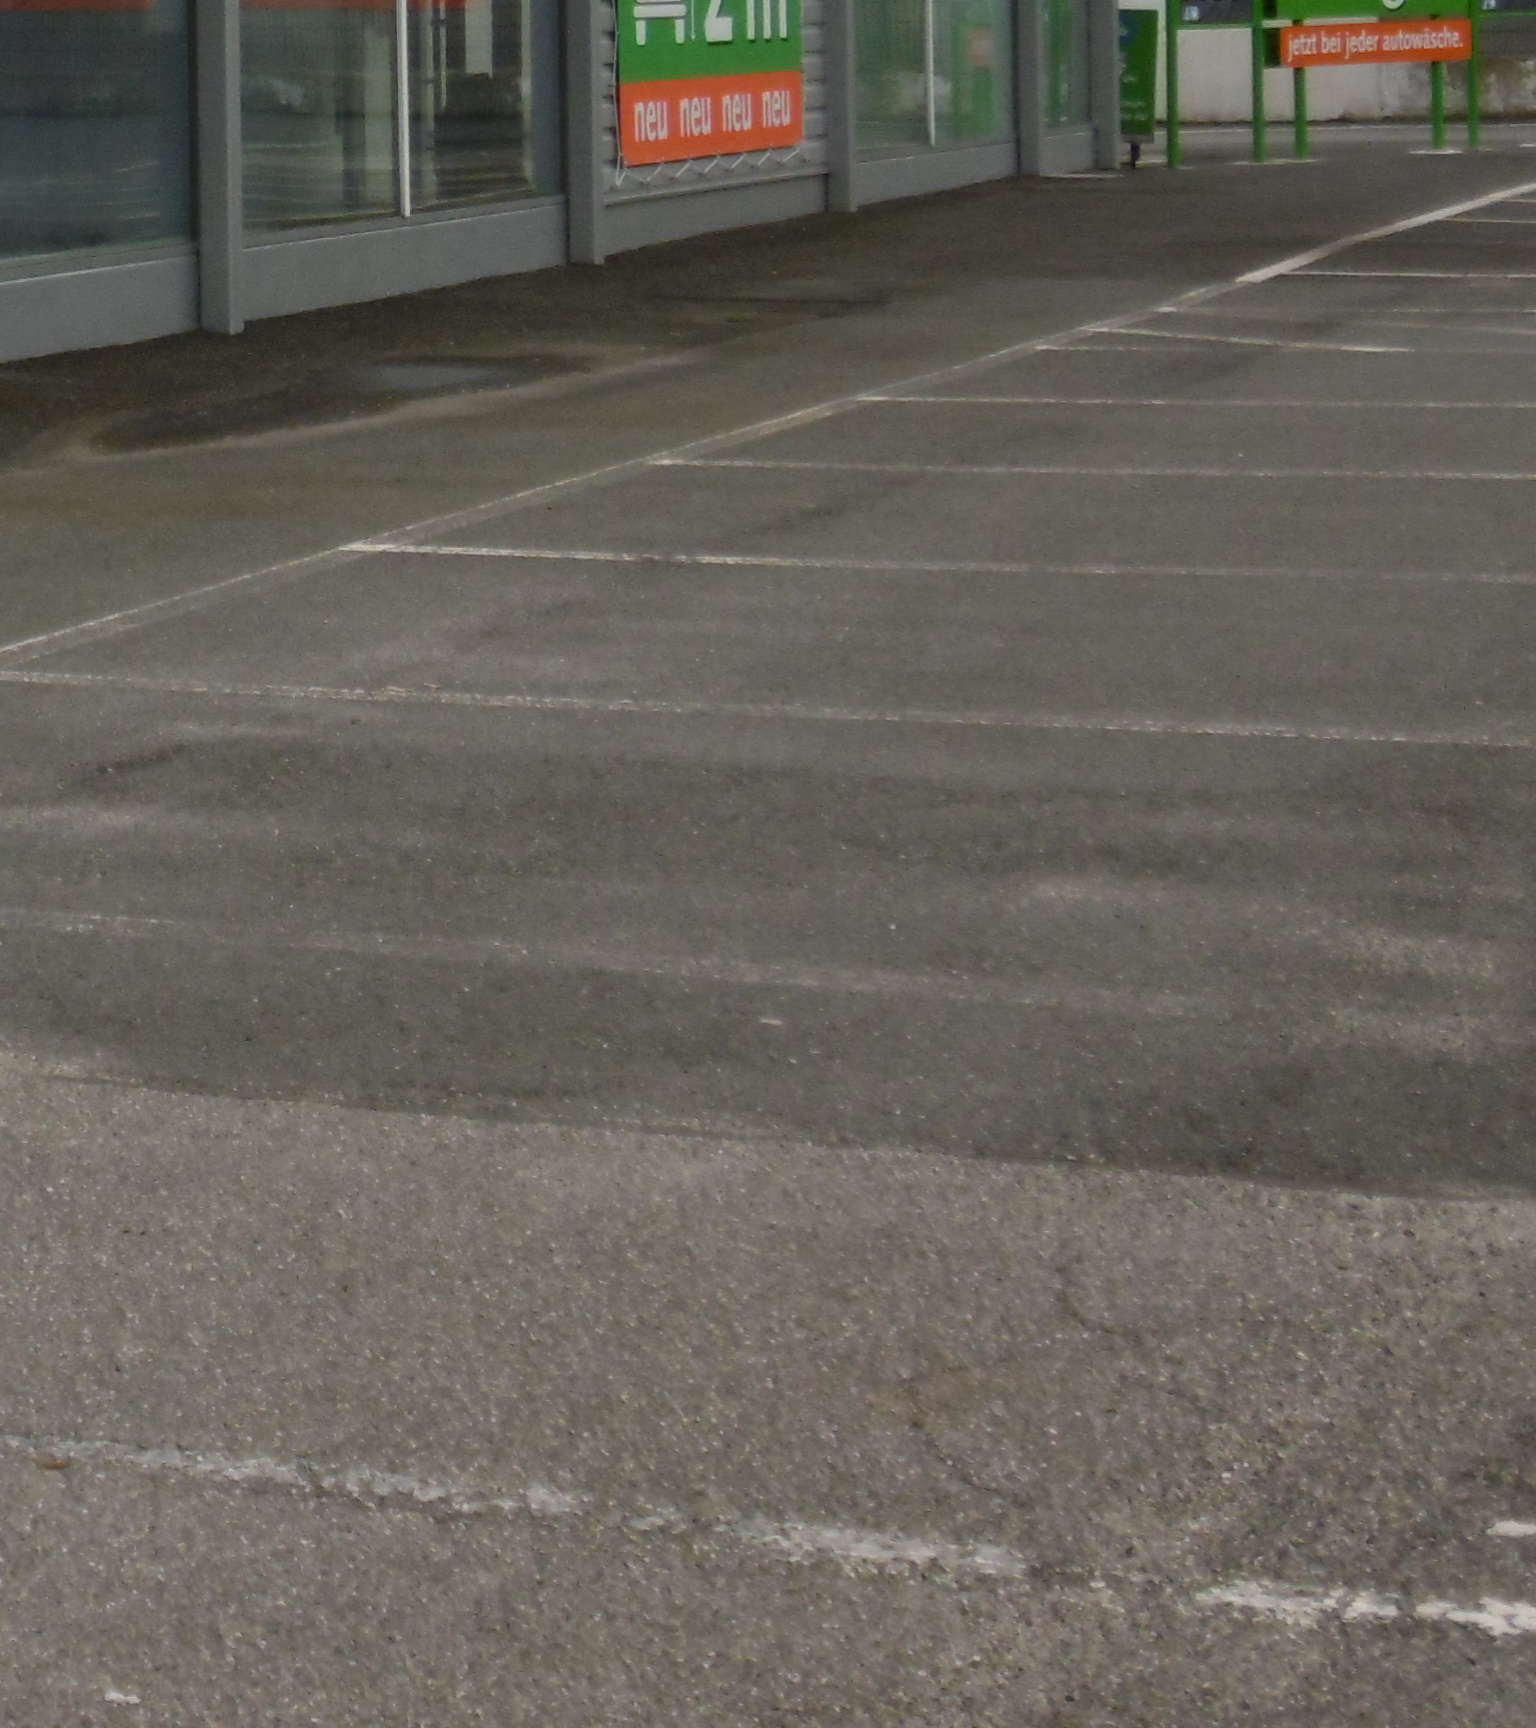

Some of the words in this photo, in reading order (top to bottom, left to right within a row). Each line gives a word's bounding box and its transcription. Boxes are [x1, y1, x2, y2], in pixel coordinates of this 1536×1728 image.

[1287, 33, 1317, 62] jetzt
[1321, 30, 1341, 55] bei
[1344, 29, 1379, 59] jeder
[1383, 26, 1463, 51] autowäsche.
[634, 97, 668, 142] neu
[679, 95, 711, 138] neu
[722, 91, 752, 133] neu
[762, 88, 791, 128] neu
